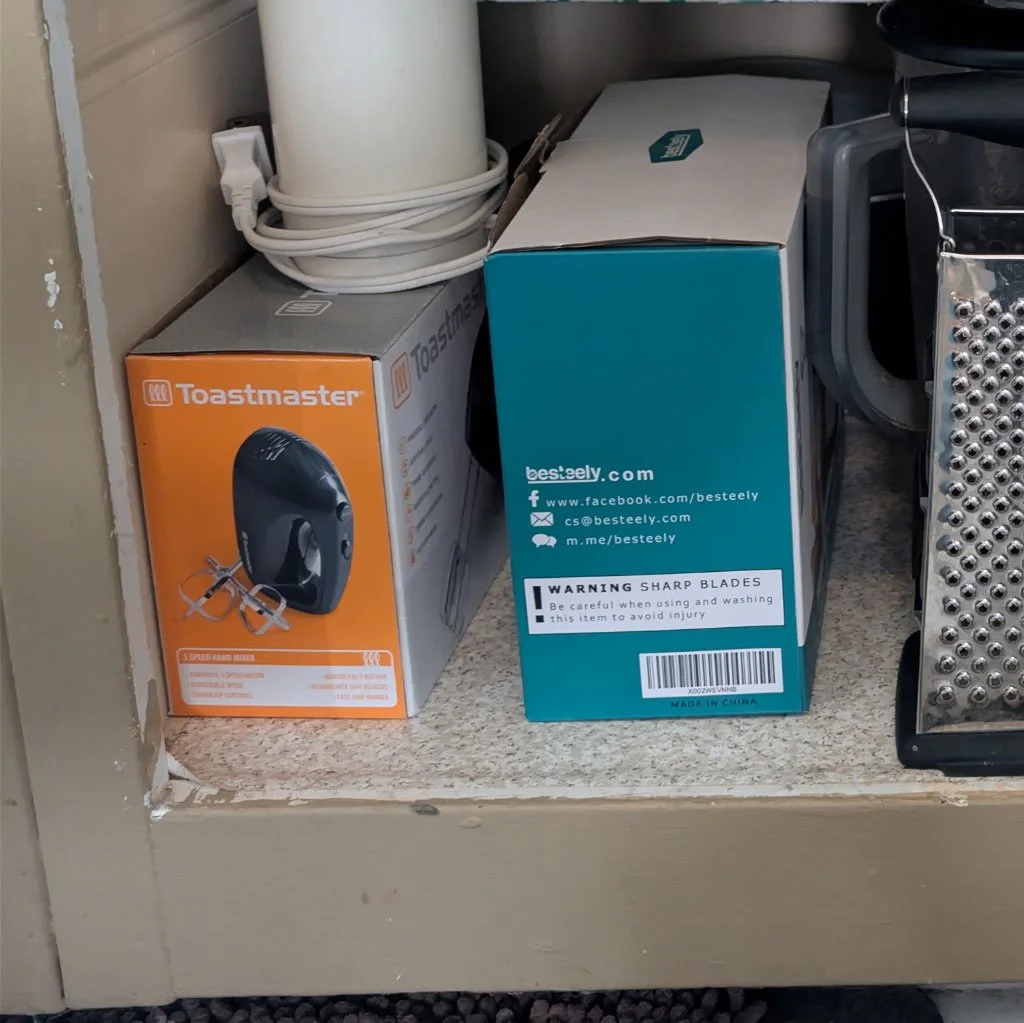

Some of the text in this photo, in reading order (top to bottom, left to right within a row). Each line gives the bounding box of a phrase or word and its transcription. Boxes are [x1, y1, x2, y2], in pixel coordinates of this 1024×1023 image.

[545, 490, 759, 508] www.facebook.com/besteely
[564, 512, 691, 527] cs@besteely.com
[566, 532, 676, 546] m.me/besteely
[548, 577, 762, 594] WARNING SHARP BLADES
[549, 595, 774, 611] Be careful when using and washing
[550, 610, 706, 623] this item to avoid injury
[670, 698, 757, 708] MADE IN CHINA
